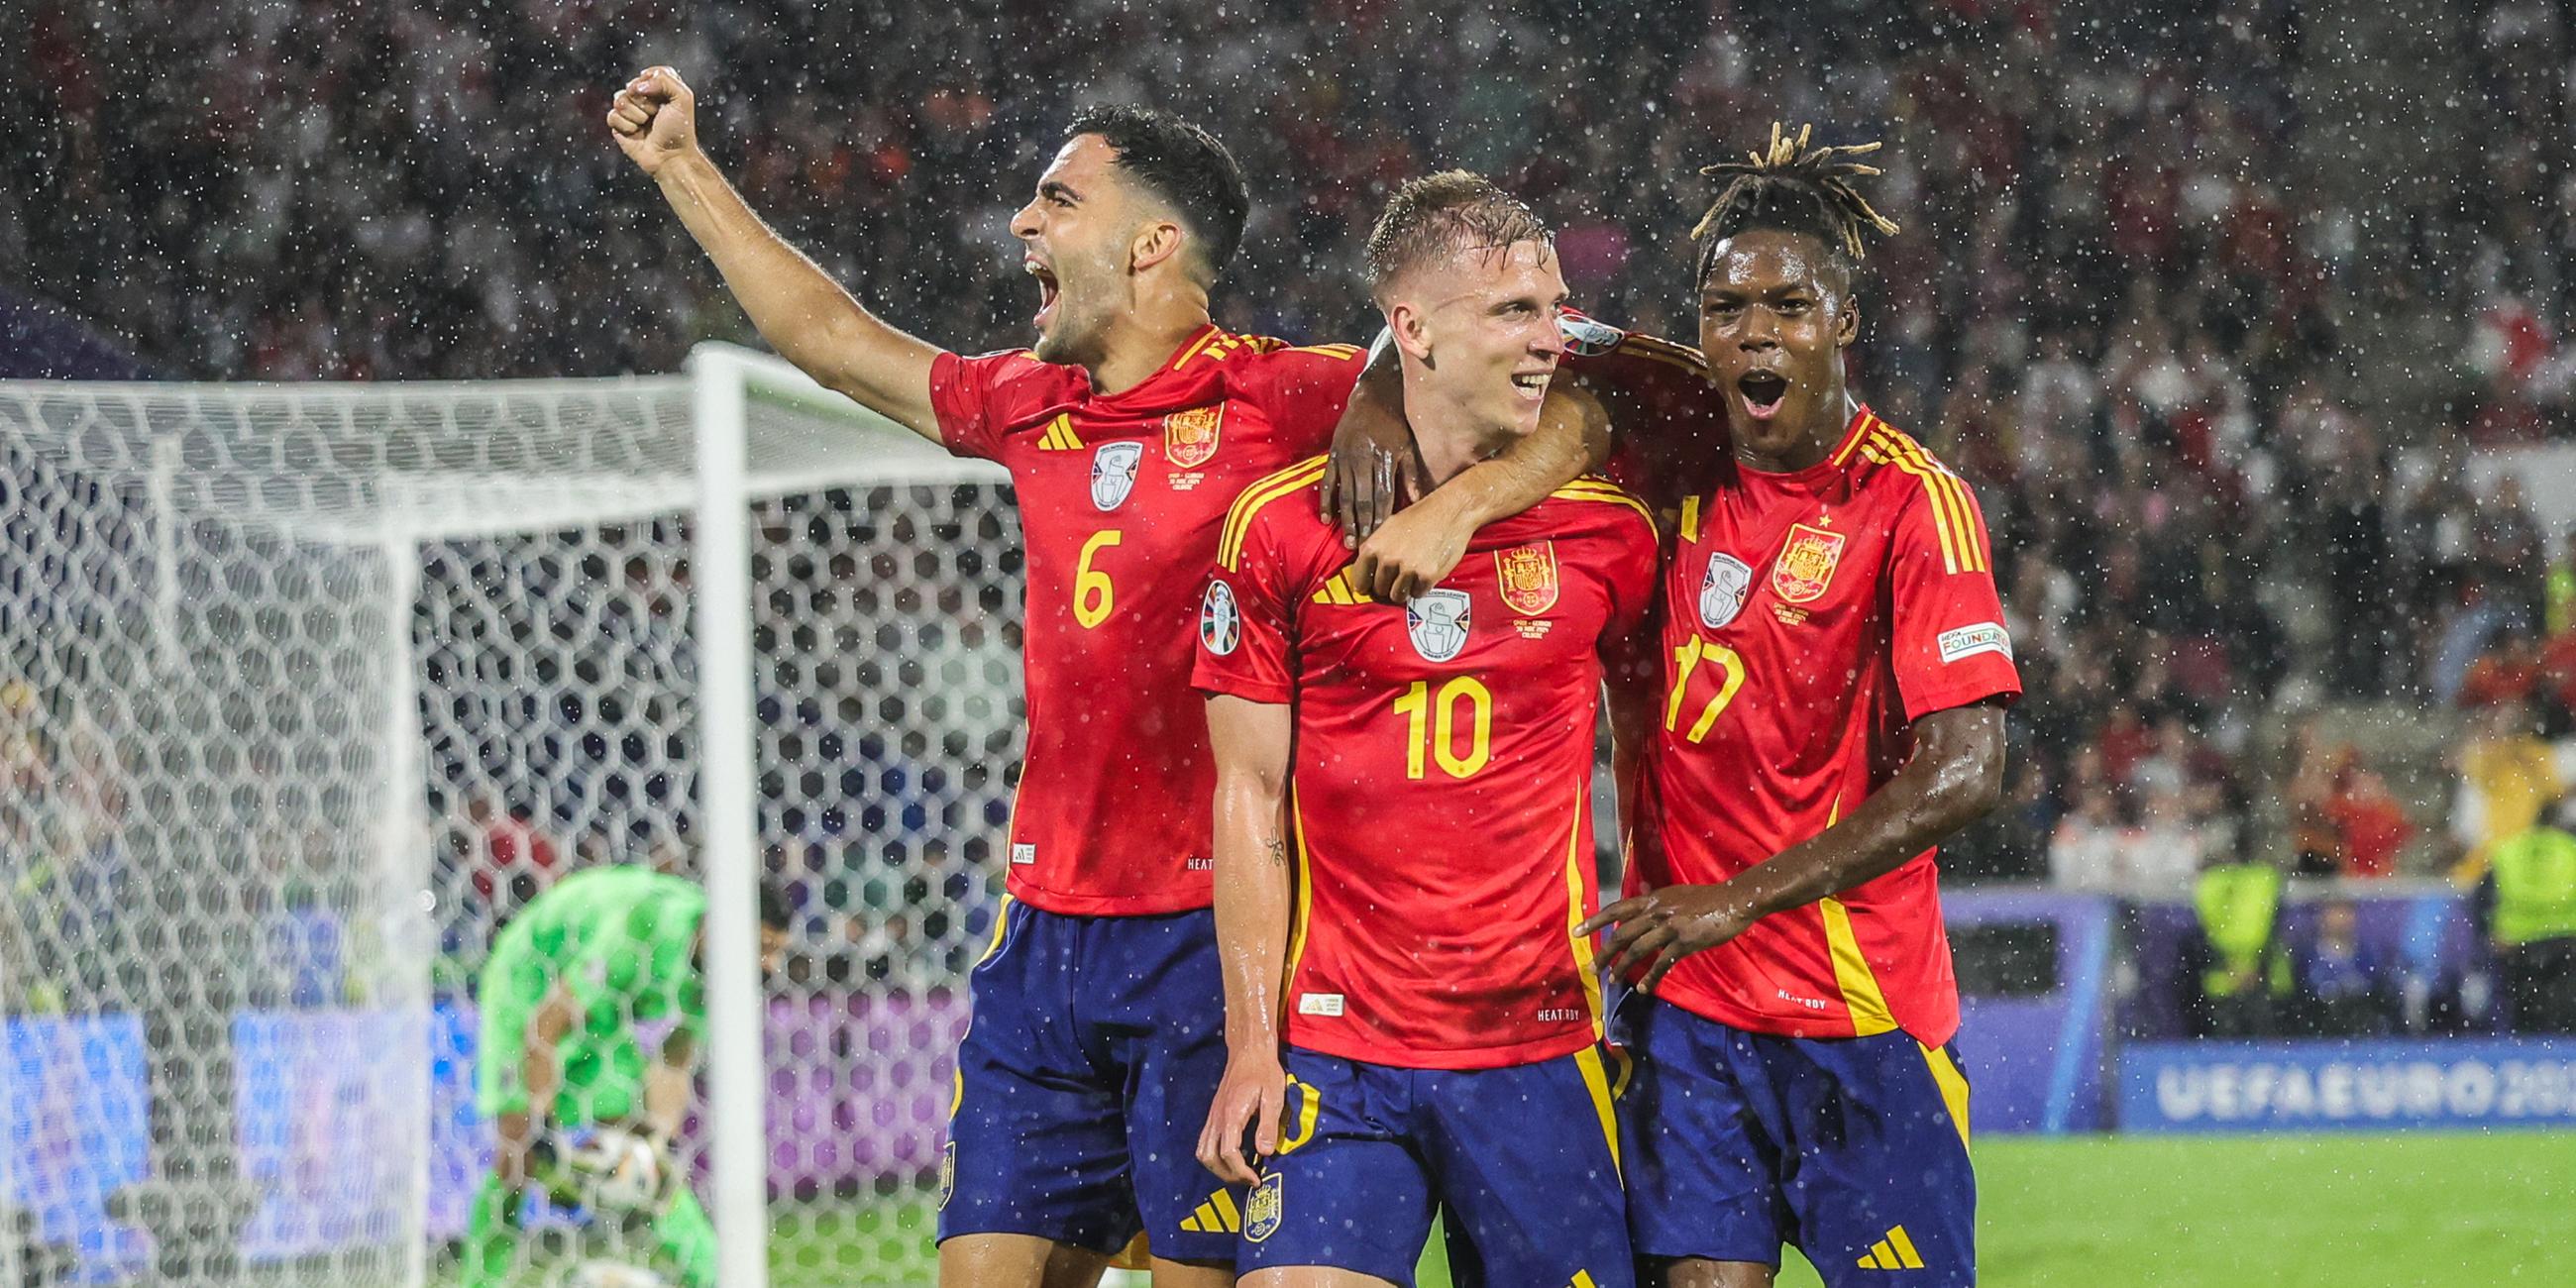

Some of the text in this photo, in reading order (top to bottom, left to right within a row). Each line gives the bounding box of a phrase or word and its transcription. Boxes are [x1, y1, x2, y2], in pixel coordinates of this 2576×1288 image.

[1073, 529, 1122, 629] 6
[1393, 676, 1492, 780] 10
[1665, 633, 1746, 744] 17
